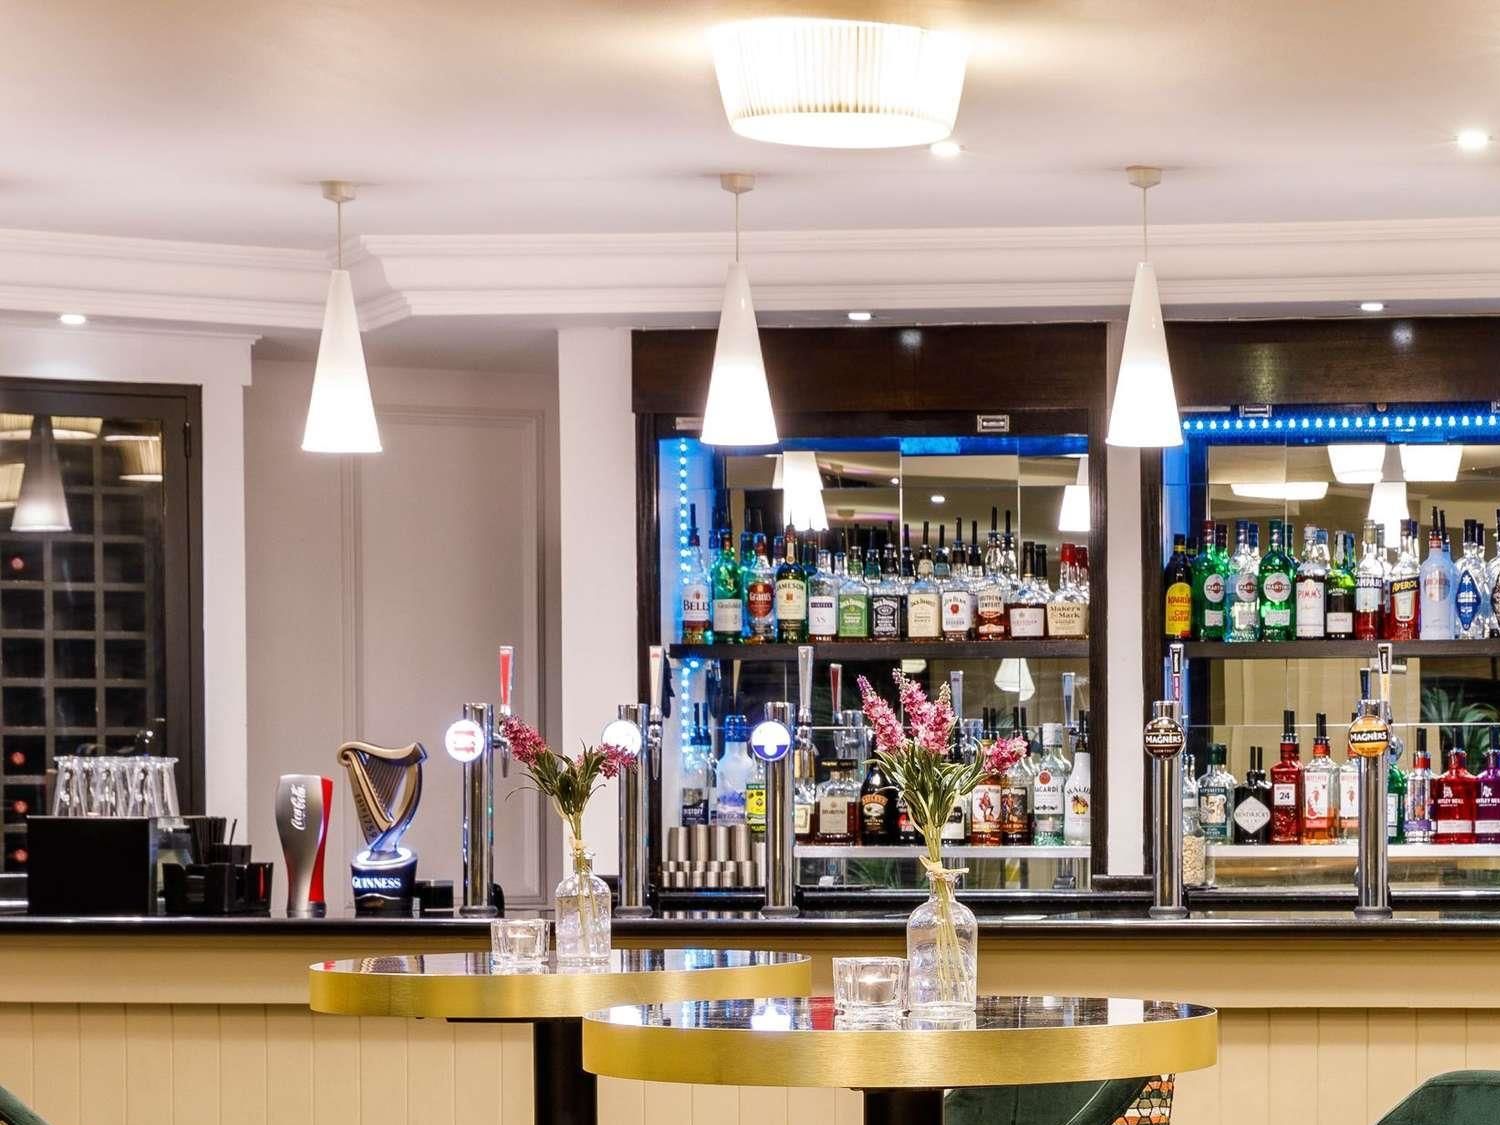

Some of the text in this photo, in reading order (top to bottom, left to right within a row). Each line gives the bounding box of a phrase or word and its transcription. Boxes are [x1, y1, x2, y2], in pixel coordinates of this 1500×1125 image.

[1146, 735, 1182, 744] MAGNERS
[1351, 731, 1387, 741] MAGNERS
[1280, 792, 1290, 800] 24
[352, 877, 401, 889] GUINNESS
